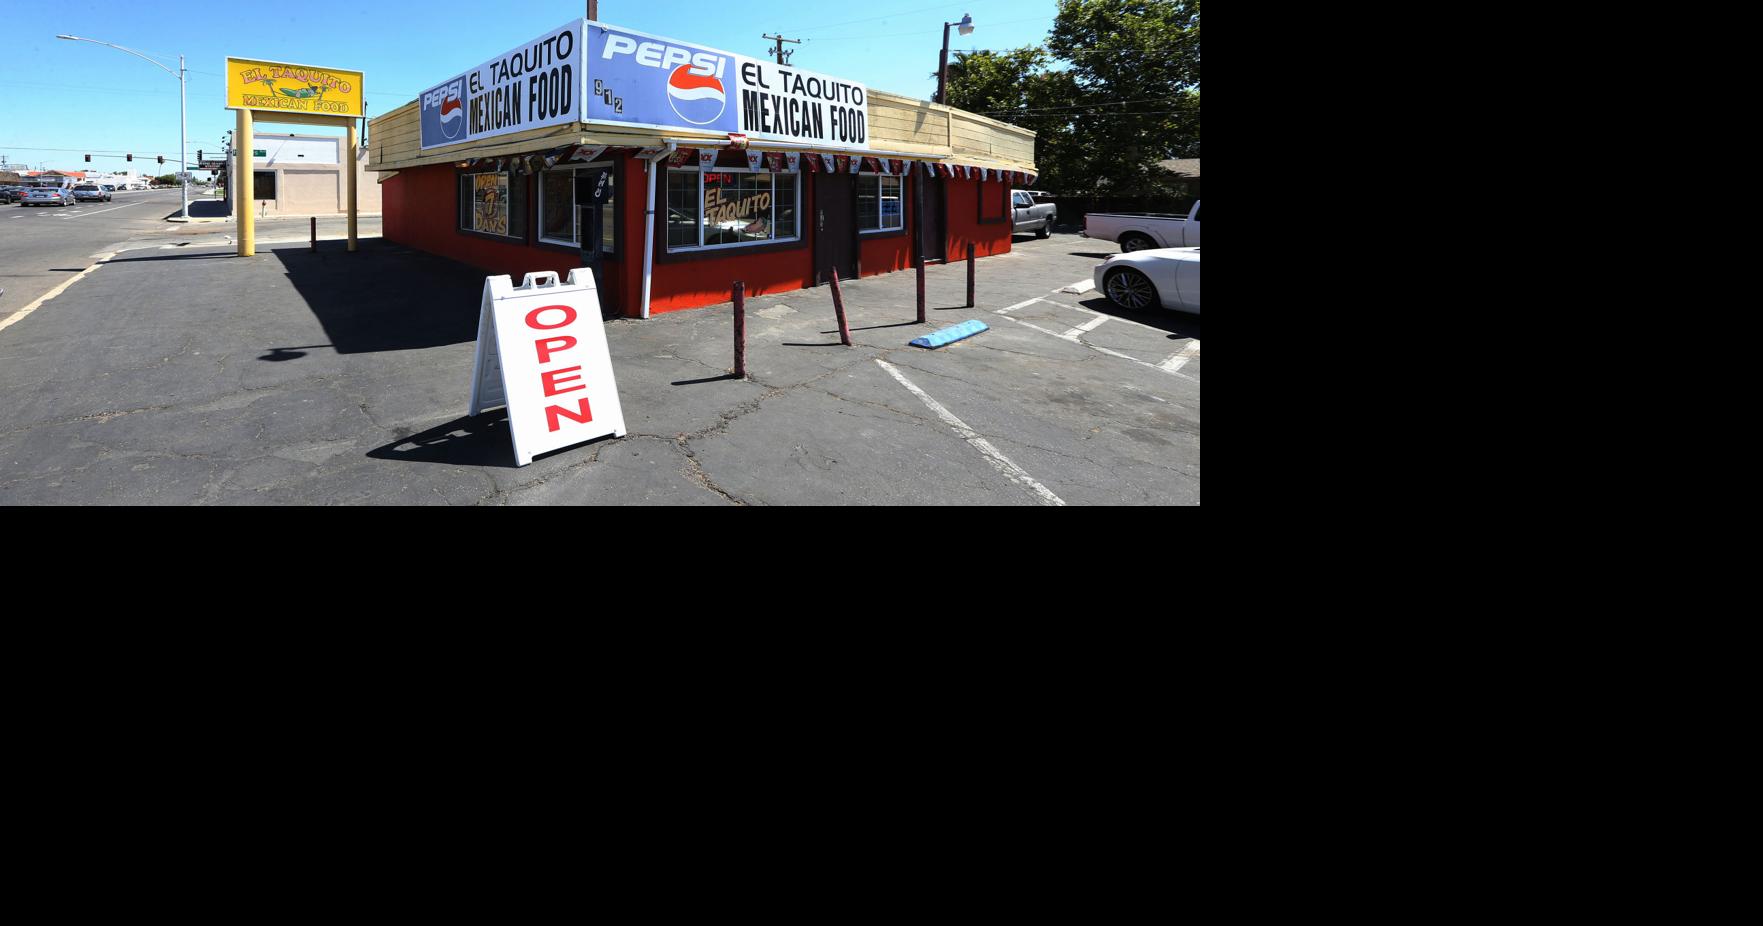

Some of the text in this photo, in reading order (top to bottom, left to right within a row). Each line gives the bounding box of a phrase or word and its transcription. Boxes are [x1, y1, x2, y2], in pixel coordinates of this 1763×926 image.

[470, 30, 573, 94] EL TAQUITO
[601, 34, 726, 79] PEPSI
[240, 66, 352, 93] EL TAQUITO
[423, 79, 463, 111] PEPSI
[594, 79, 623, 113] 912
[741, 62, 864, 106] EL TAQUITO
[242, 95, 349, 112] MEXICAN FOOD
[469, 63, 572, 135] MEXICAN FOOD
[742, 88, 865, 144] MEXICAN FOOD
[475, 174, 497, 192] OPEN
[704, 173, 733, 185] OPEN
[705, 187, 727, 208] EL
[705, 192, 770, 227] TAQUITO
[524, 304, 593, 432] OPEN
